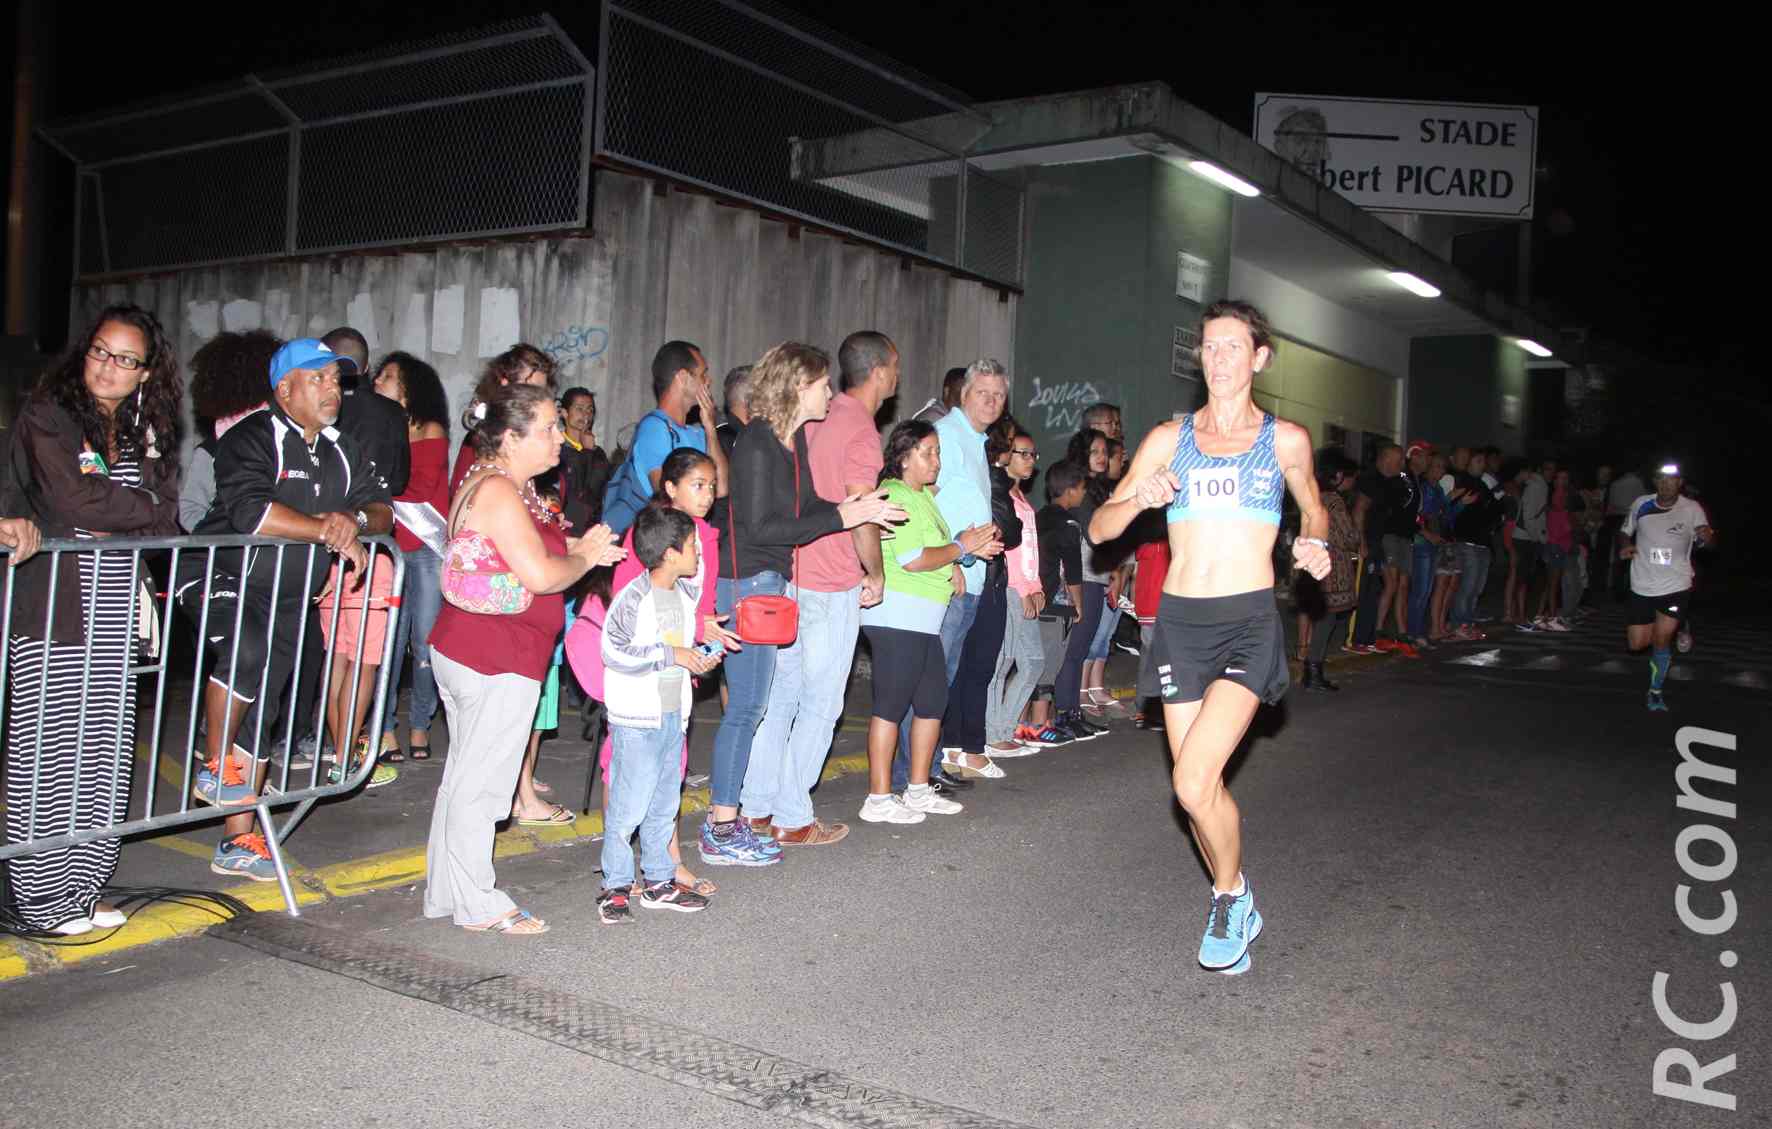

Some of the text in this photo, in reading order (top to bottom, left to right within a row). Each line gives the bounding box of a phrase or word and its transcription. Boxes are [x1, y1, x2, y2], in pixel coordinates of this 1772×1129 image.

[1420, 118, 1517, 146] STADE
[1320, 159, 1513, 199] bert PICARD
[1194, 478, 1235, 497] 100
